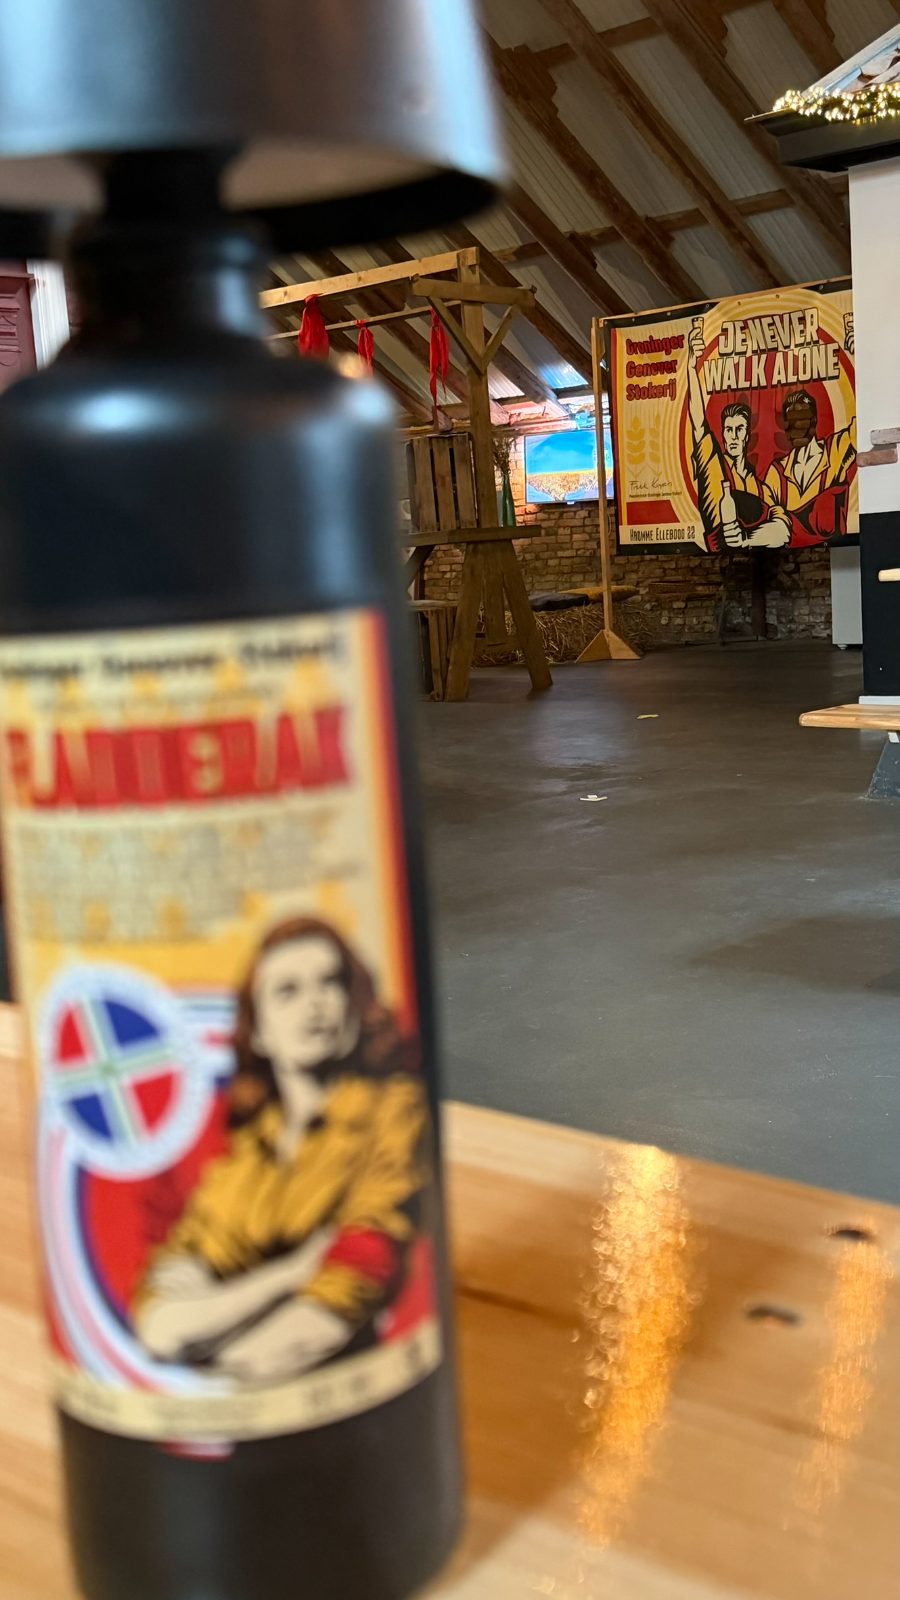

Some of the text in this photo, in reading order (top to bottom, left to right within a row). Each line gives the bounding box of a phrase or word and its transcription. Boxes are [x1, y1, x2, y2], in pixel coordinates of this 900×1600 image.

[718, 307, 820, 356] JENEVER
[626, 334, 684, 355] Groninger
[626, 360, 678, 378] Genever
[703, 342, 840, 395] WALK ALONE
[626, 378, 677, 401] Stokerij
[687, 525, 696, 539] 22
